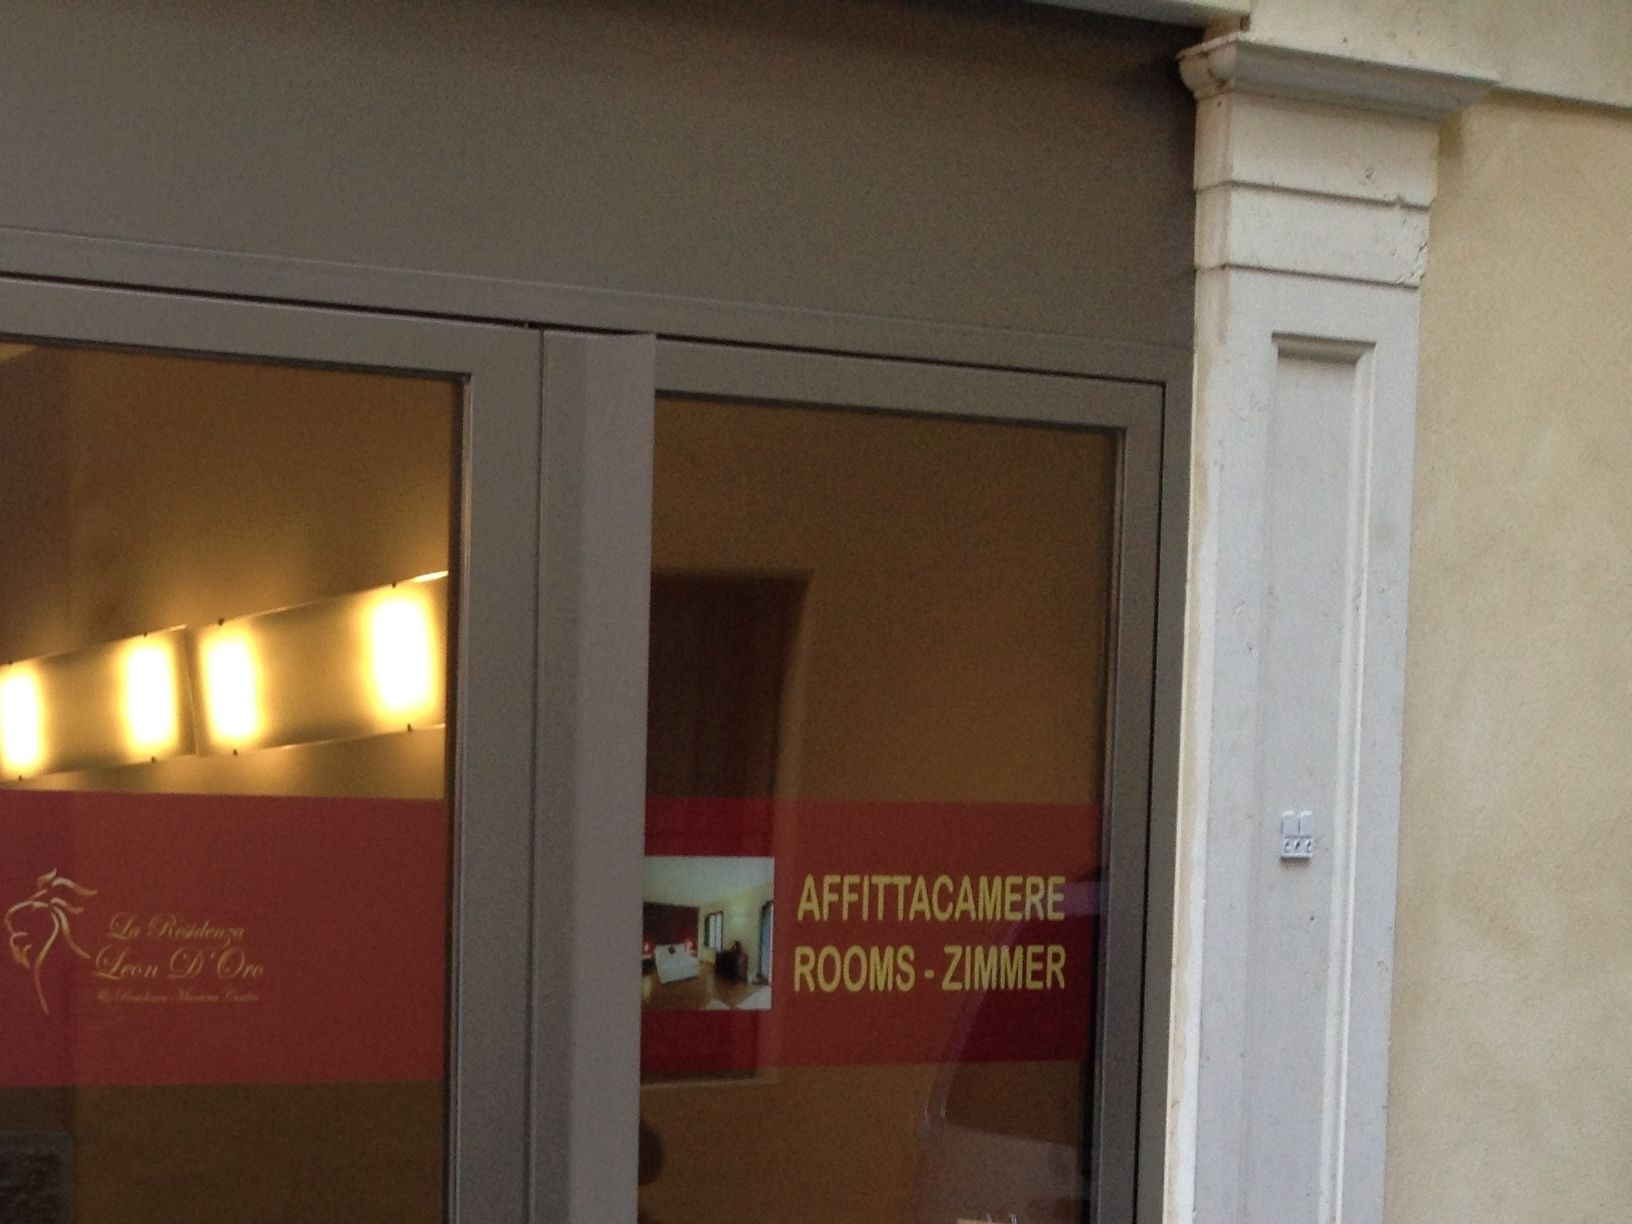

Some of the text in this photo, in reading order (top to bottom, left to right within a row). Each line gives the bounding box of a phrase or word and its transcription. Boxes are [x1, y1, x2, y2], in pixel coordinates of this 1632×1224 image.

[797, 874, 1066, 922] AFFITTACAMERE
[107, 912, 244, 948] La Residenza
[93, 944, 159, 980] Leon
[794, 945, 915, 993] ROOMS
[942, 944, 1066, 991] ZIMMER
